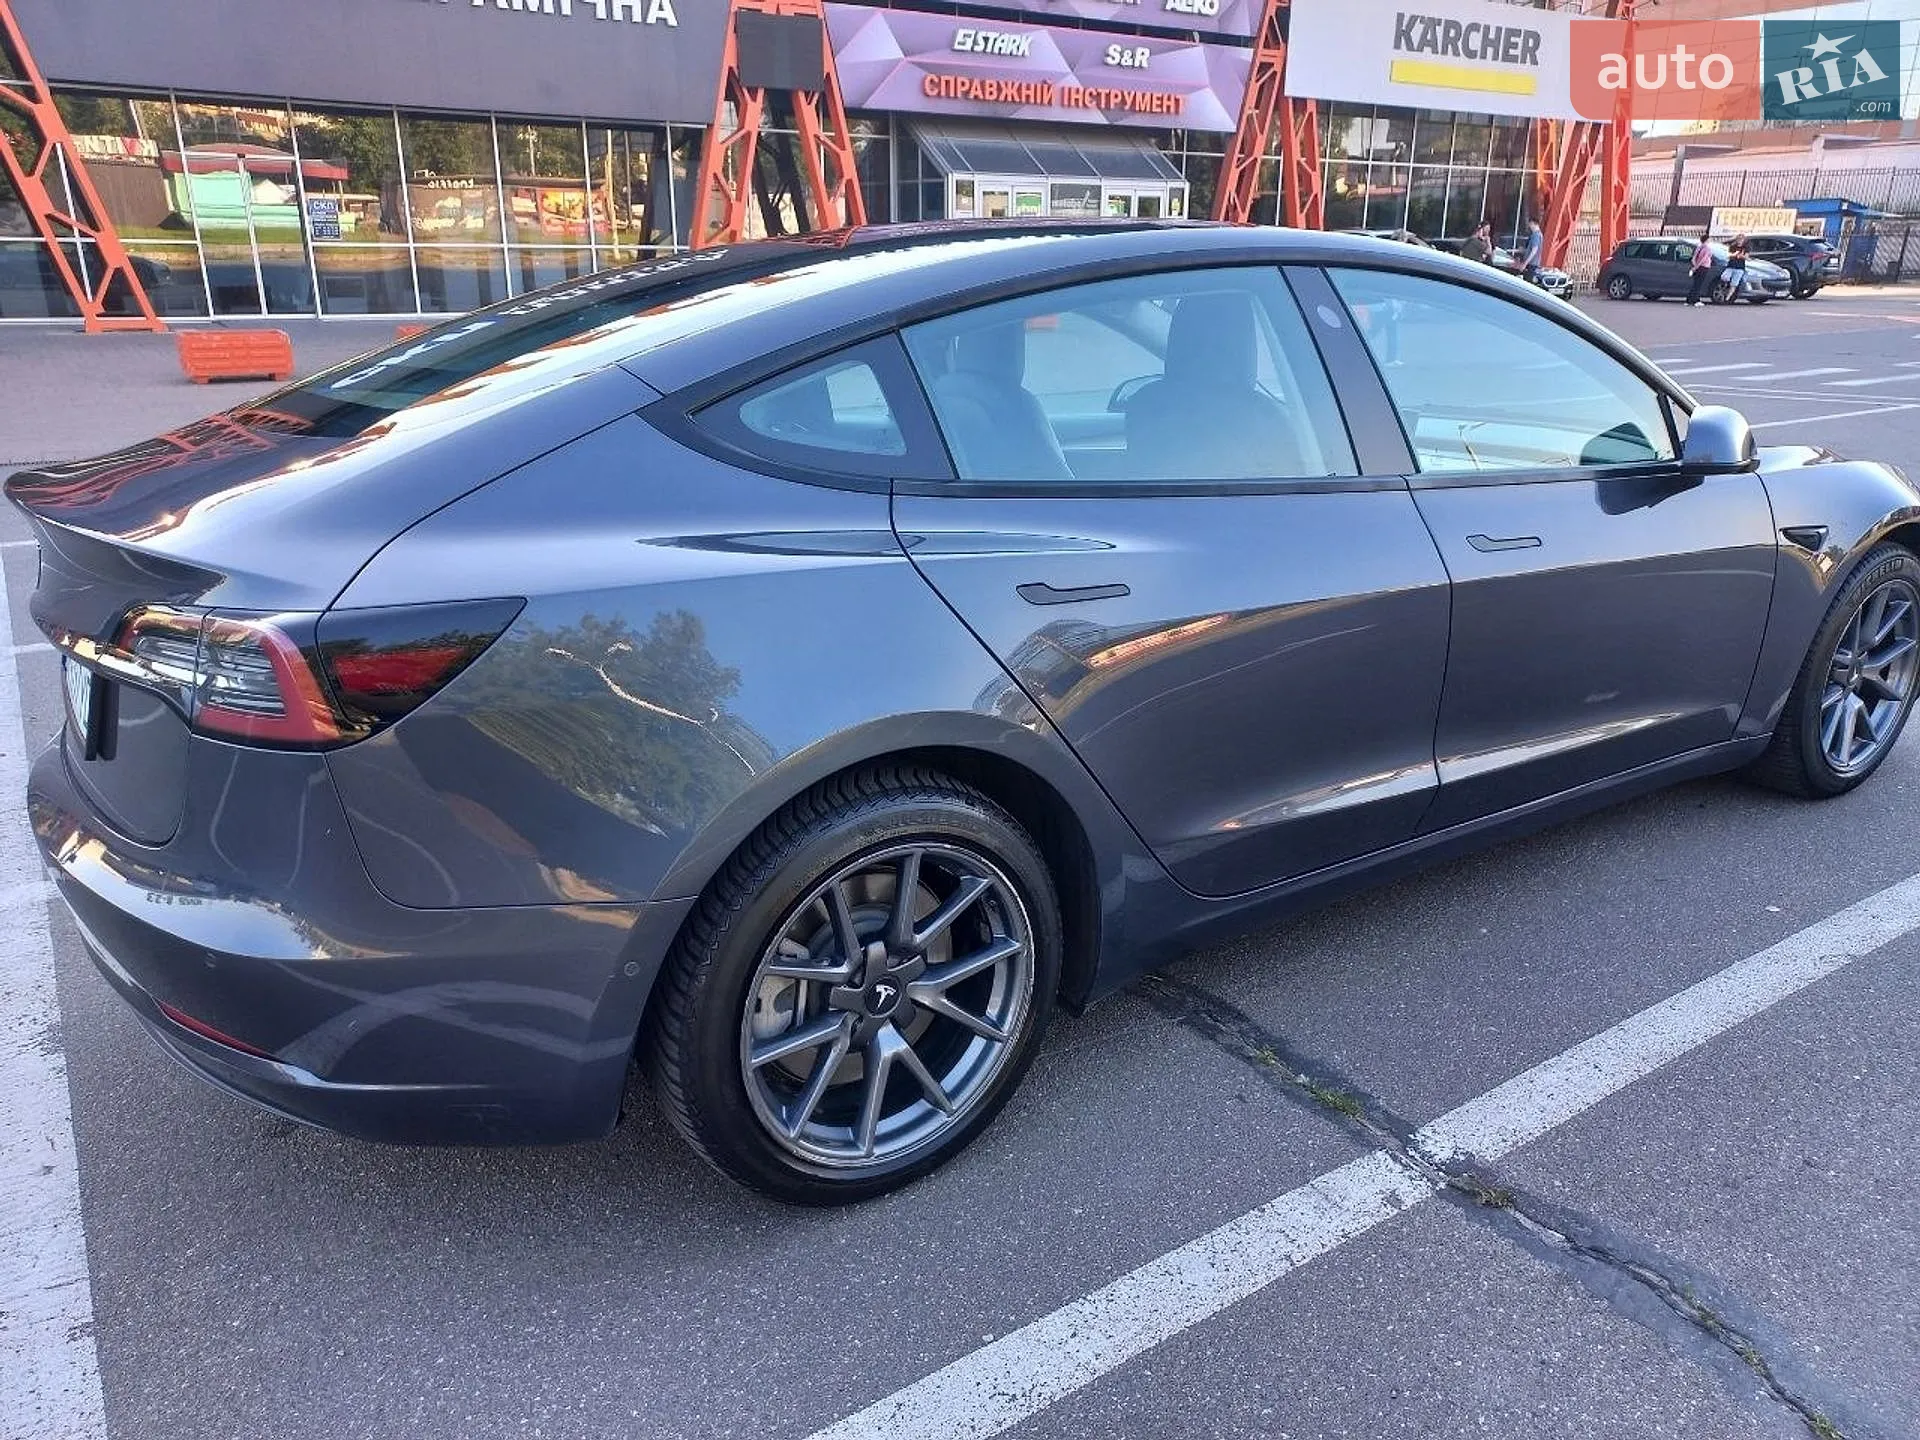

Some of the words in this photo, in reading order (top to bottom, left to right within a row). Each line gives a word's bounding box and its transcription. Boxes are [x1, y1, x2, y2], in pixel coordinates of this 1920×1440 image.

[973, 32, 1032, 57] STARK
[1393, 12, 1542, 66] KÄRCHER
[1105, 44, 1151, 68] S&R
[924, 74, 1055, 105] СПРАВЖНІЙ
[1062, 85, 1184, 114] ІНСТРУМЕНТ
[1716, 210, 1792, 227] ГЕНЕРАТОРИ
